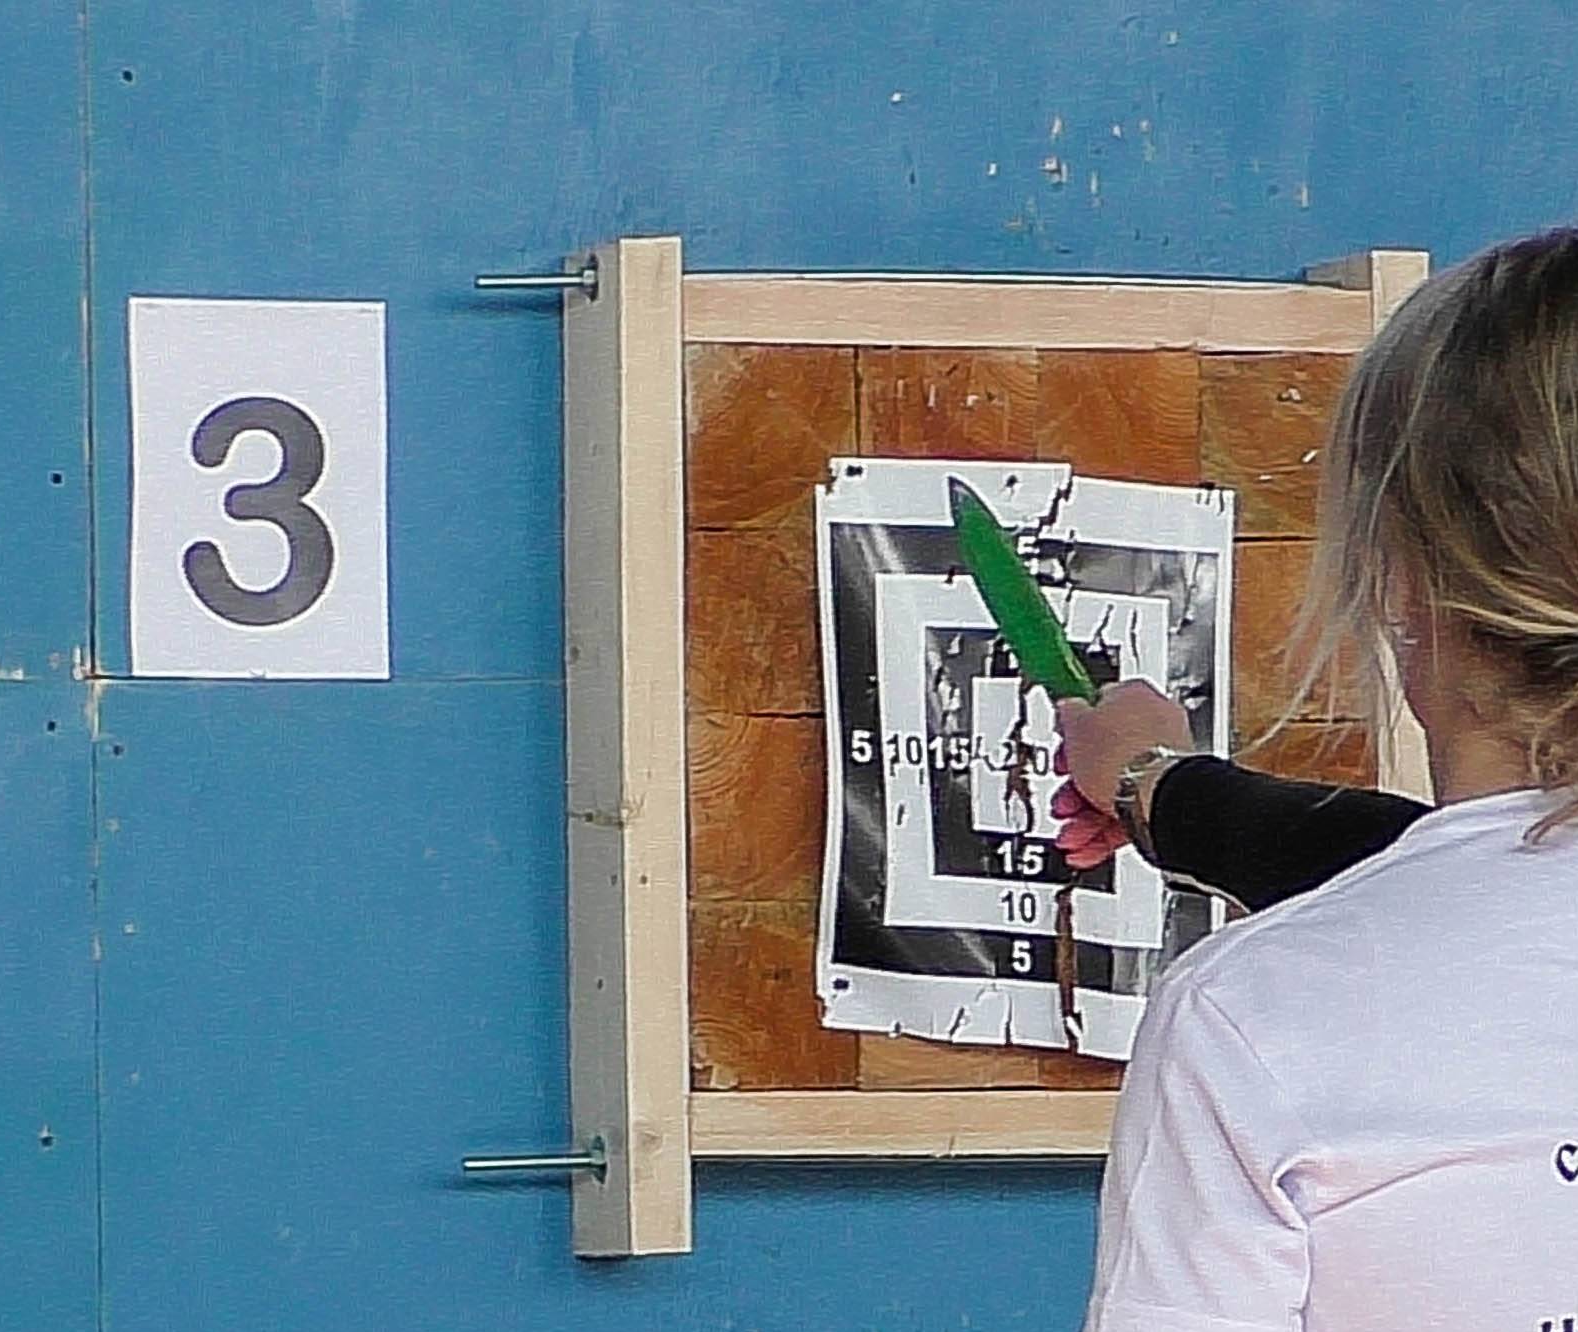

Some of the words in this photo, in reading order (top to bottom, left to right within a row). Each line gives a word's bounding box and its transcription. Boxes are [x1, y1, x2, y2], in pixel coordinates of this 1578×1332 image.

[184, 397, 334, 626] 3
[851, 730, 872, 763] 5
[886, 734, 921, 766] 10
[929, 737, 970, 770] 15
[997, 840, 1045, 874] 15
[1001, 896, 1036, 923] 10
[1012, 940, 1032, 972] 5
